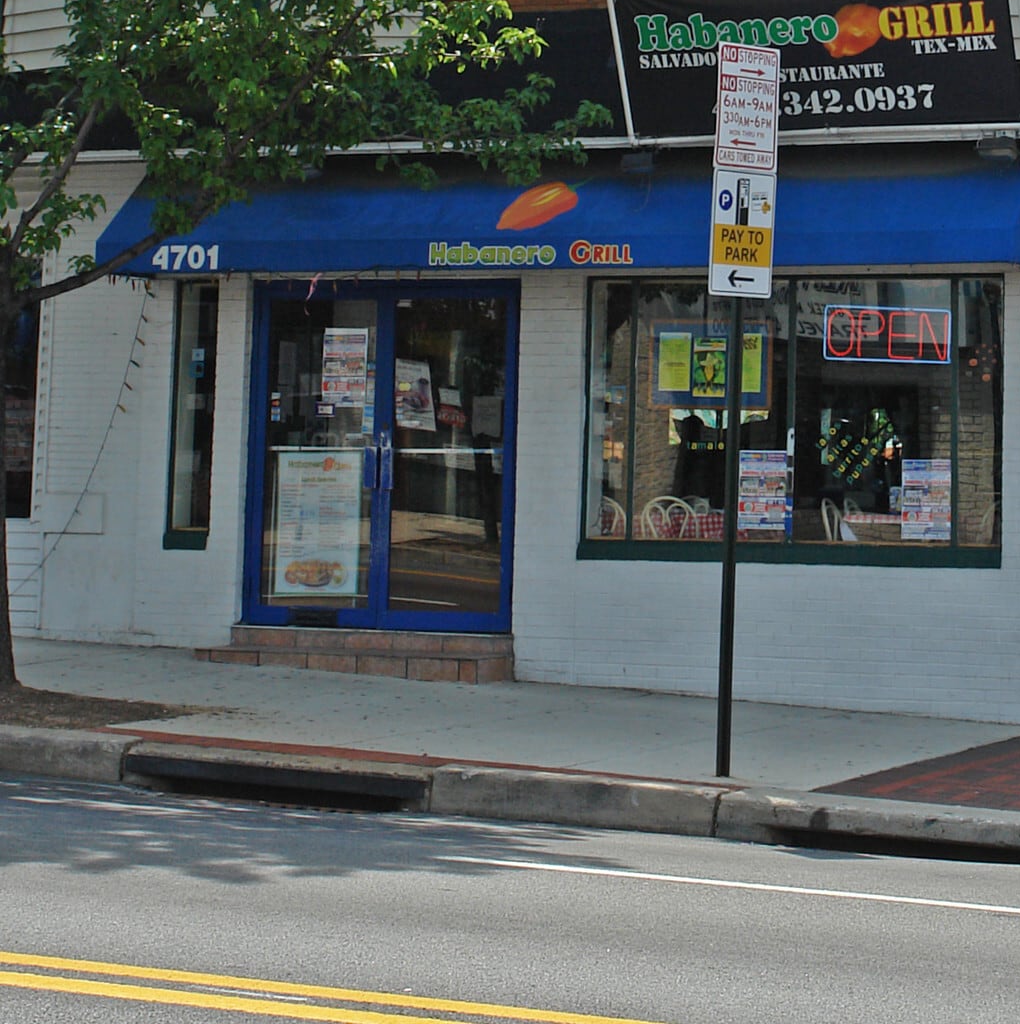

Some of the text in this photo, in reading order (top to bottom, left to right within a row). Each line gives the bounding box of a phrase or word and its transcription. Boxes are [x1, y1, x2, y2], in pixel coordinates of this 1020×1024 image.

[634, 0, 995, 52] Habanero GRILL
[911, 34, 997, 54] TEX-MEX
[639, 51, 719, 69] SALVADO
[723, 46, 776, 67] NO STOPPING
[779, 63, 885, 83] STAURANTE
[722, 76, 775, 96] NO STOPPING
[721, 228, 764, 245] PAY TO
[152, 244, 219, 270] 4701
[429, 241, 556, 266] Habanero
[725, 246, 758, 263] PARK
[827, 309, 949, 360] OPEN
